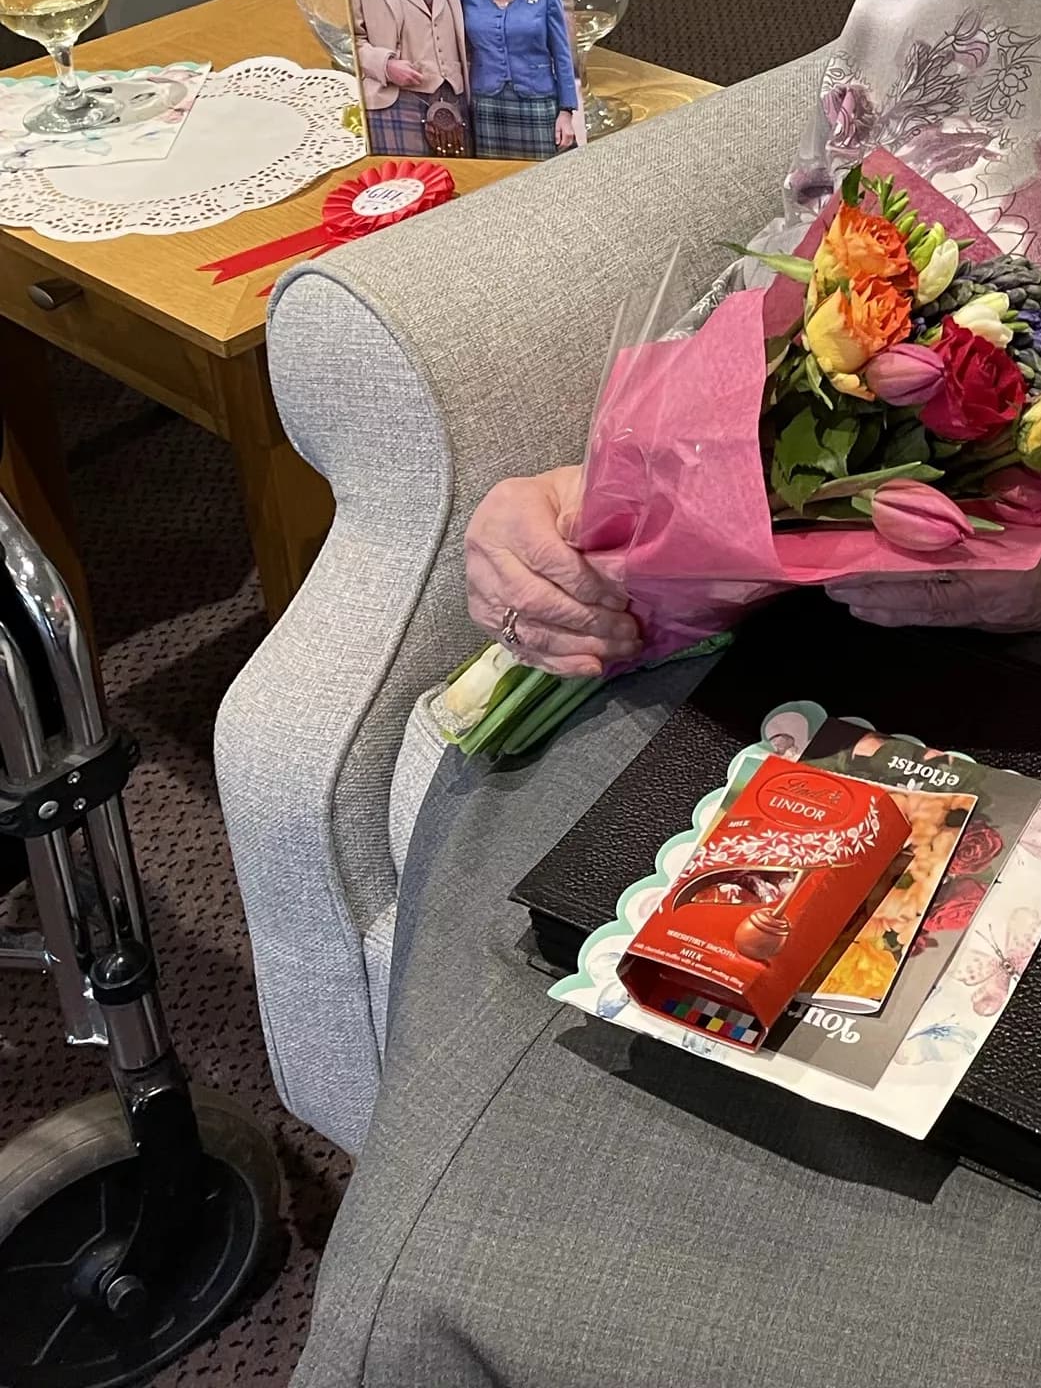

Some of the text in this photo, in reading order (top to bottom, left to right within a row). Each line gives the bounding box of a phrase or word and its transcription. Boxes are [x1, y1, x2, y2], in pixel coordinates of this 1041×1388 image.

[888, 755, 960, 787] eflorist
[768, 795, 827, 823] LINDOR
[679, 947, 705, 962] MILK
